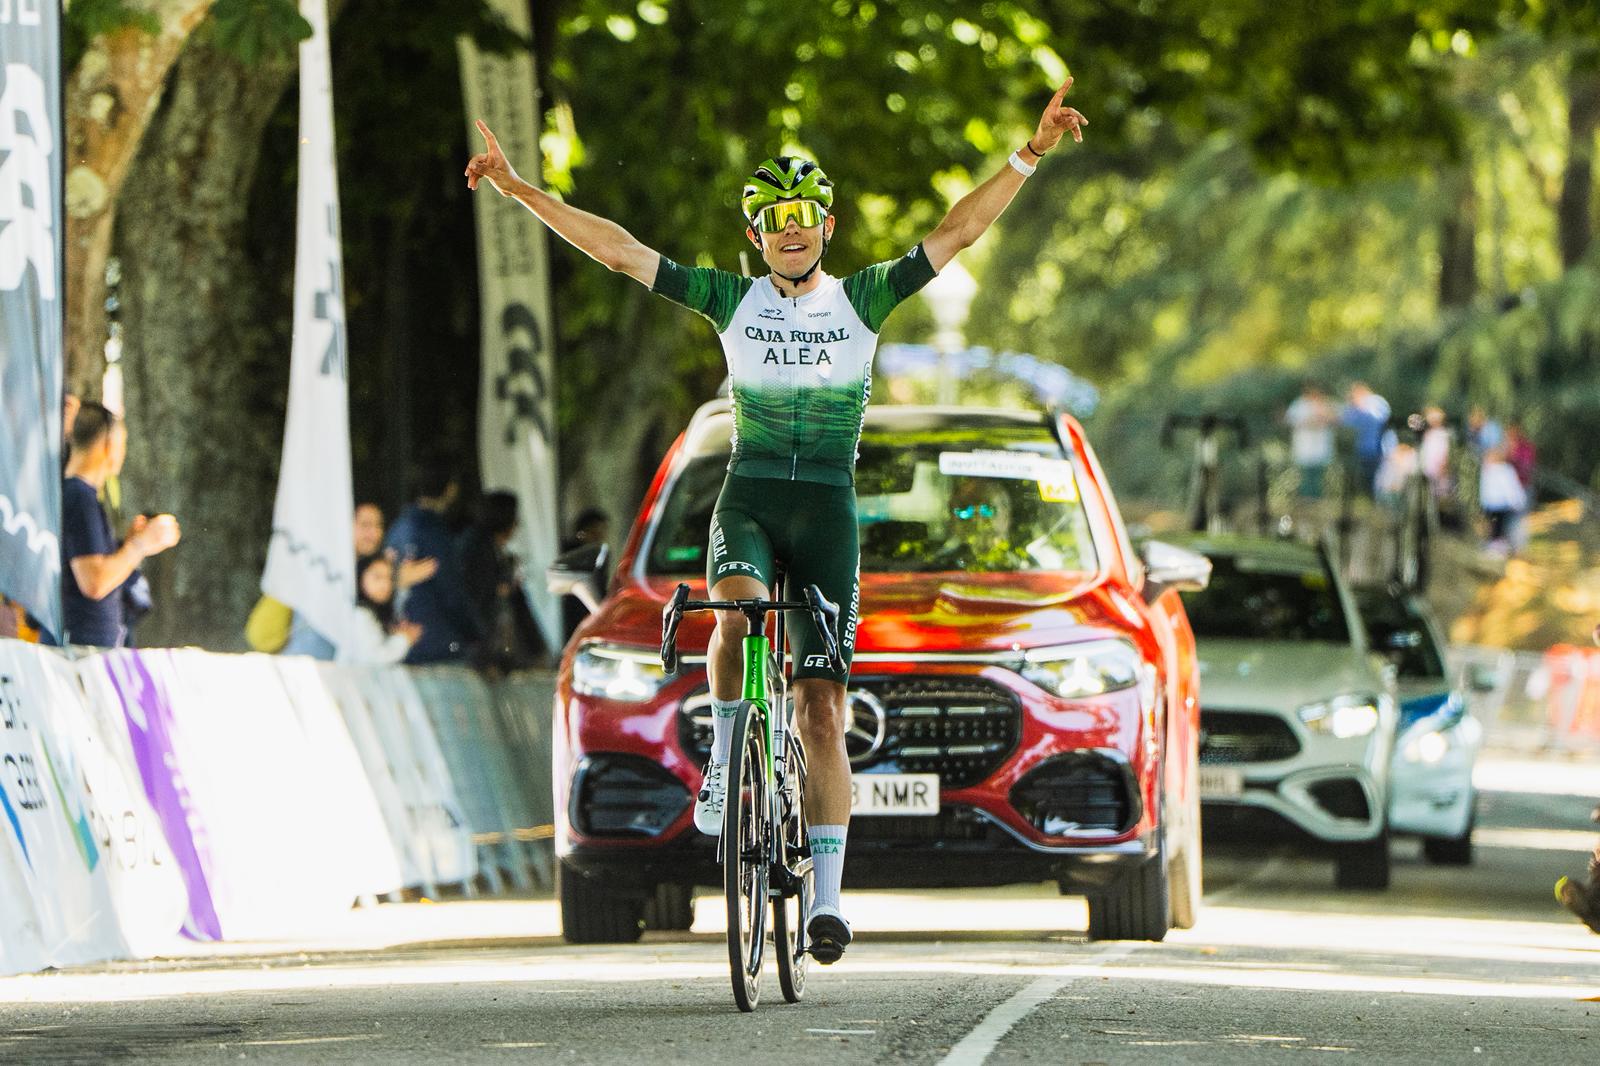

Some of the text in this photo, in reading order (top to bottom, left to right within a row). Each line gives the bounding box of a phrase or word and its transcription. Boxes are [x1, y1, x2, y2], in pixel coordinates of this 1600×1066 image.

[745, 326, 849, 343] CAJA RURAL
[763, 348, 832, 365] ALEA
[843, 583, 860, 649] SEGUROS
[873, 782, 928, 806] NMR
[813, 846, 838, 855] ALEA
